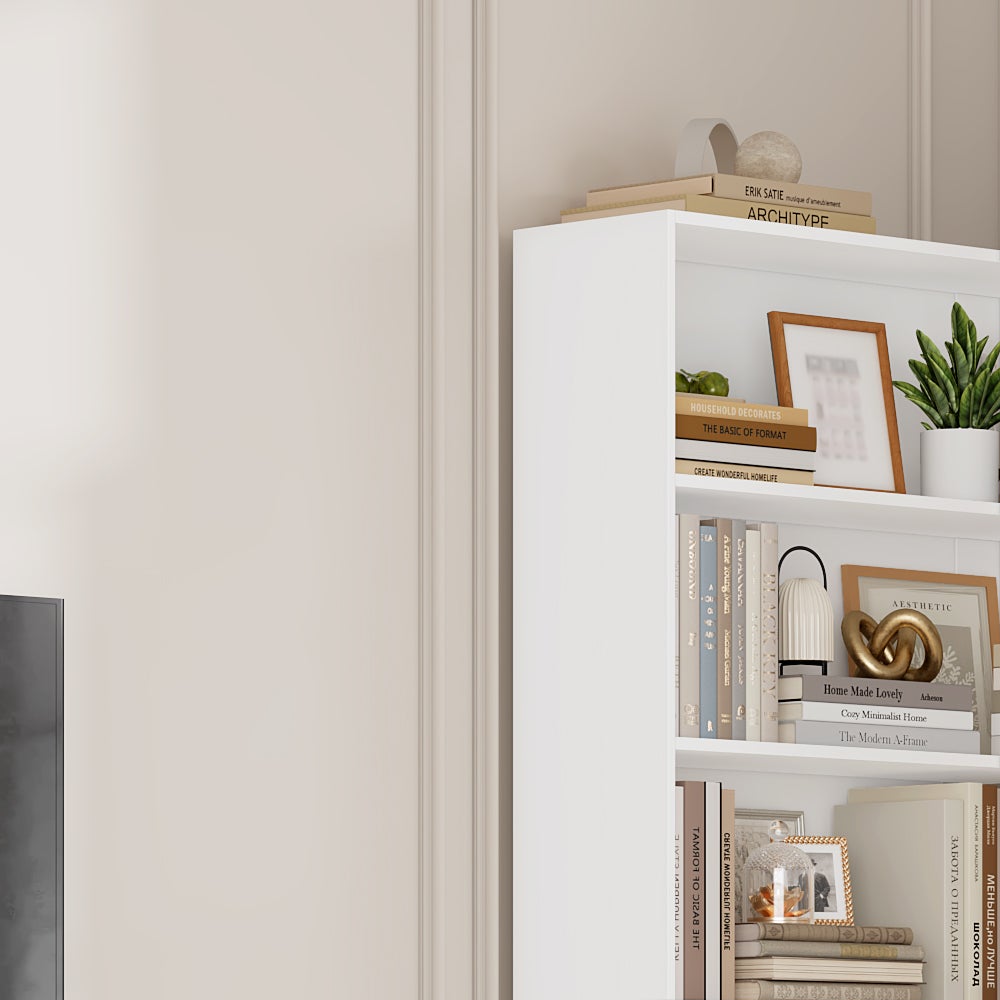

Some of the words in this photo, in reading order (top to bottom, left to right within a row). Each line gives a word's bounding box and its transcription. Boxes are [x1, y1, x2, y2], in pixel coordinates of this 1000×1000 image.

[745, 186, 762, 198] ERIK
[764, 188, 784, 201] SATIE
[785, 195, 804, 204] musique
[747, 206, 830, 228] ARCHITYPE
[690, 402, 736, 416] HOUSEHOLD
[738, 407, 782, 420] DECORATES
[702, 423, 718, 434] THE
[720, 425, 742, 436] BASIC
[743, 428, 753, 437] OF
[755, 428, 787, 440] FORMAT
[694, 467, 715, 477] CREATE
[716, 470, 750, 480] WONDERFUL
[751, 473, 778, 482] HOMELIFE
[763, 574, 776, 645] BLACK
[892, 600, 952, 611] AESTHETIC
[763, 652, 776, 700] KEY
[824, 684, 848, 696] Home
[850, 686, 874, 698] Made
[876, 688, 903, 702] Lovely
[841, 709, 860, 720] Cozy
[862, 710, 901, 721] Minimalist
[903, 713, 927, 722] Home
[839, 731, 856, 742] The
[859, 732, 891, 745] Modern
[893, 735, 928, 747] A-Frame
[951, 888, 958, 898] О
[950, 901, 958, 982] ПРЕДАННЫХ
